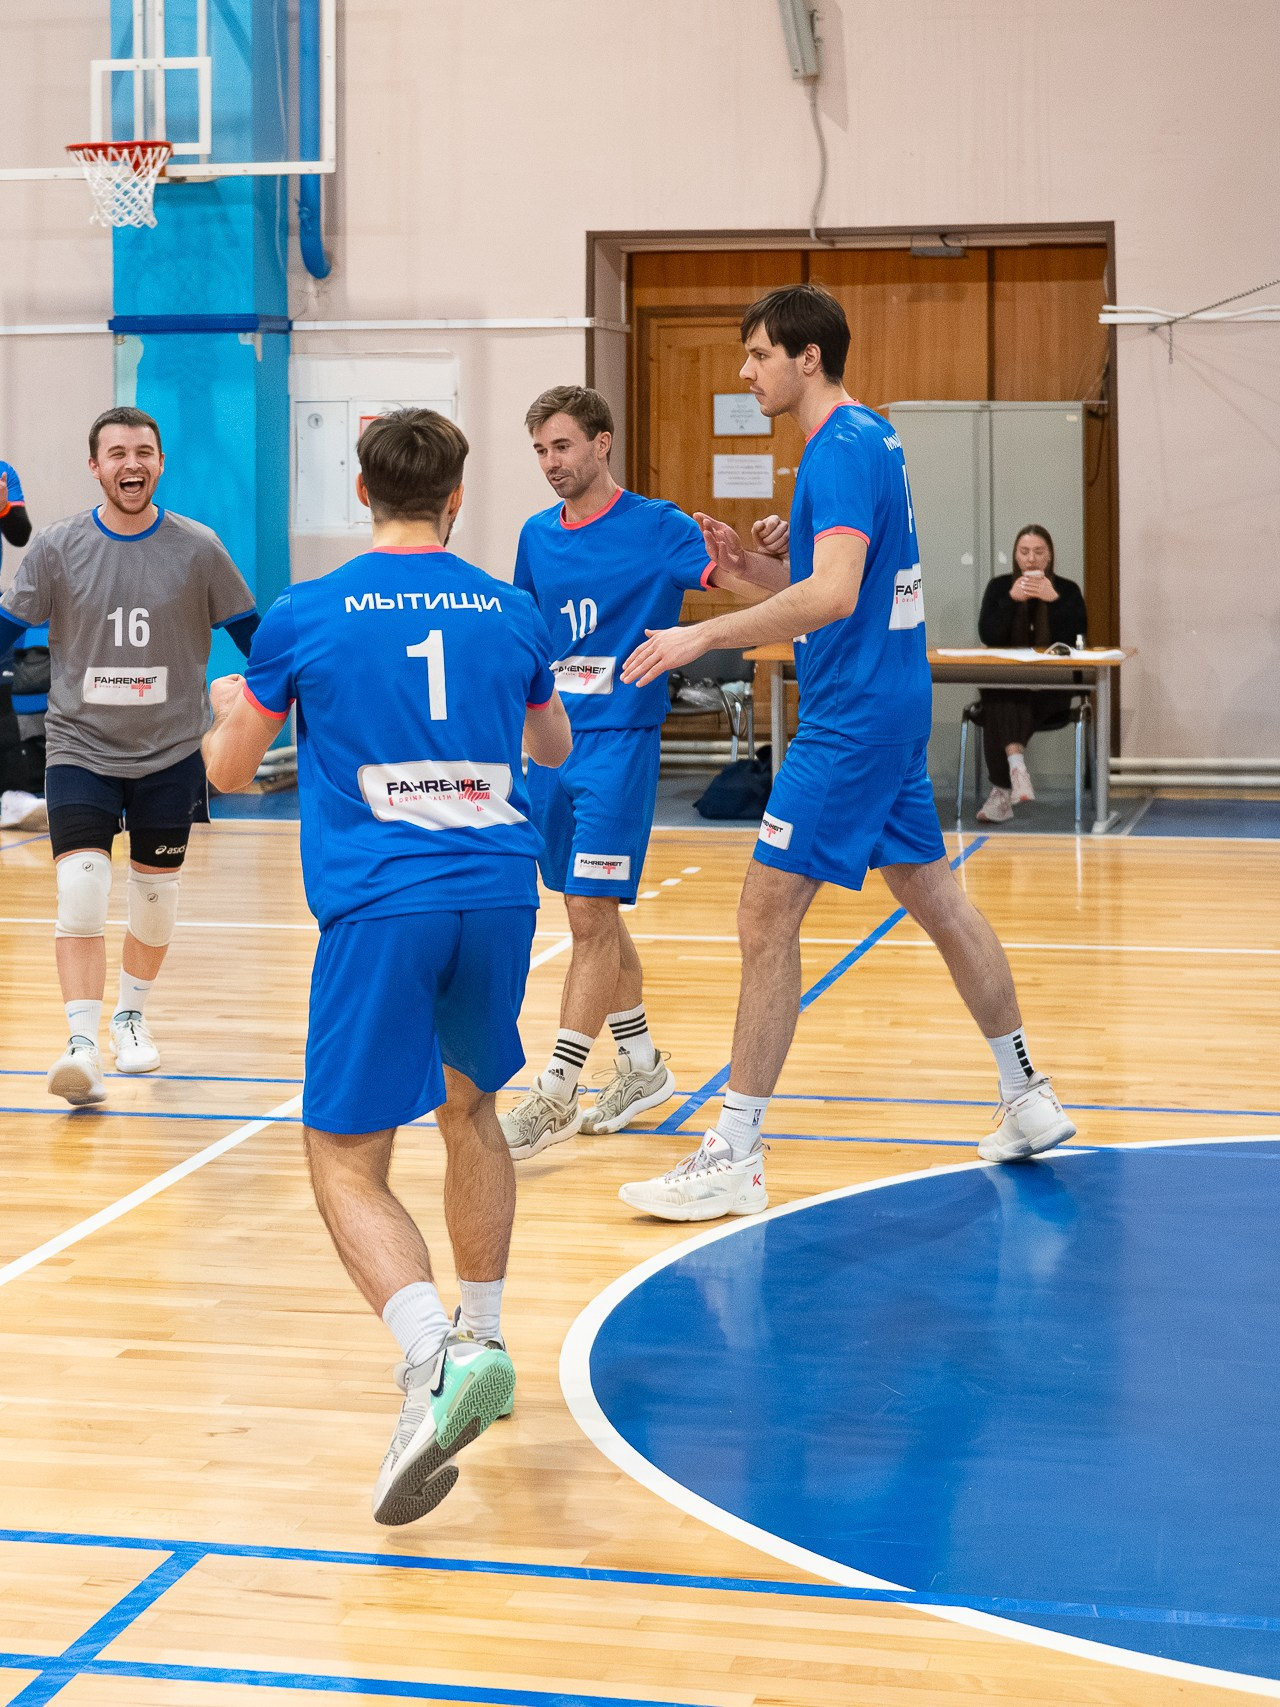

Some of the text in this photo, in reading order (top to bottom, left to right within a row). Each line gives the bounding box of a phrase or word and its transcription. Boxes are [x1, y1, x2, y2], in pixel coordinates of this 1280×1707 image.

[344, 592, 503, 613] МЫТИЩИ
[107, 607, 151, 647] 16
[560, 597, 598, 641] 10
[94, 676, 158, 685] FAHRENHEIT
[406, 629, 448, 721] 1
[580, 859, 623, 867] FAHRENHEIT
